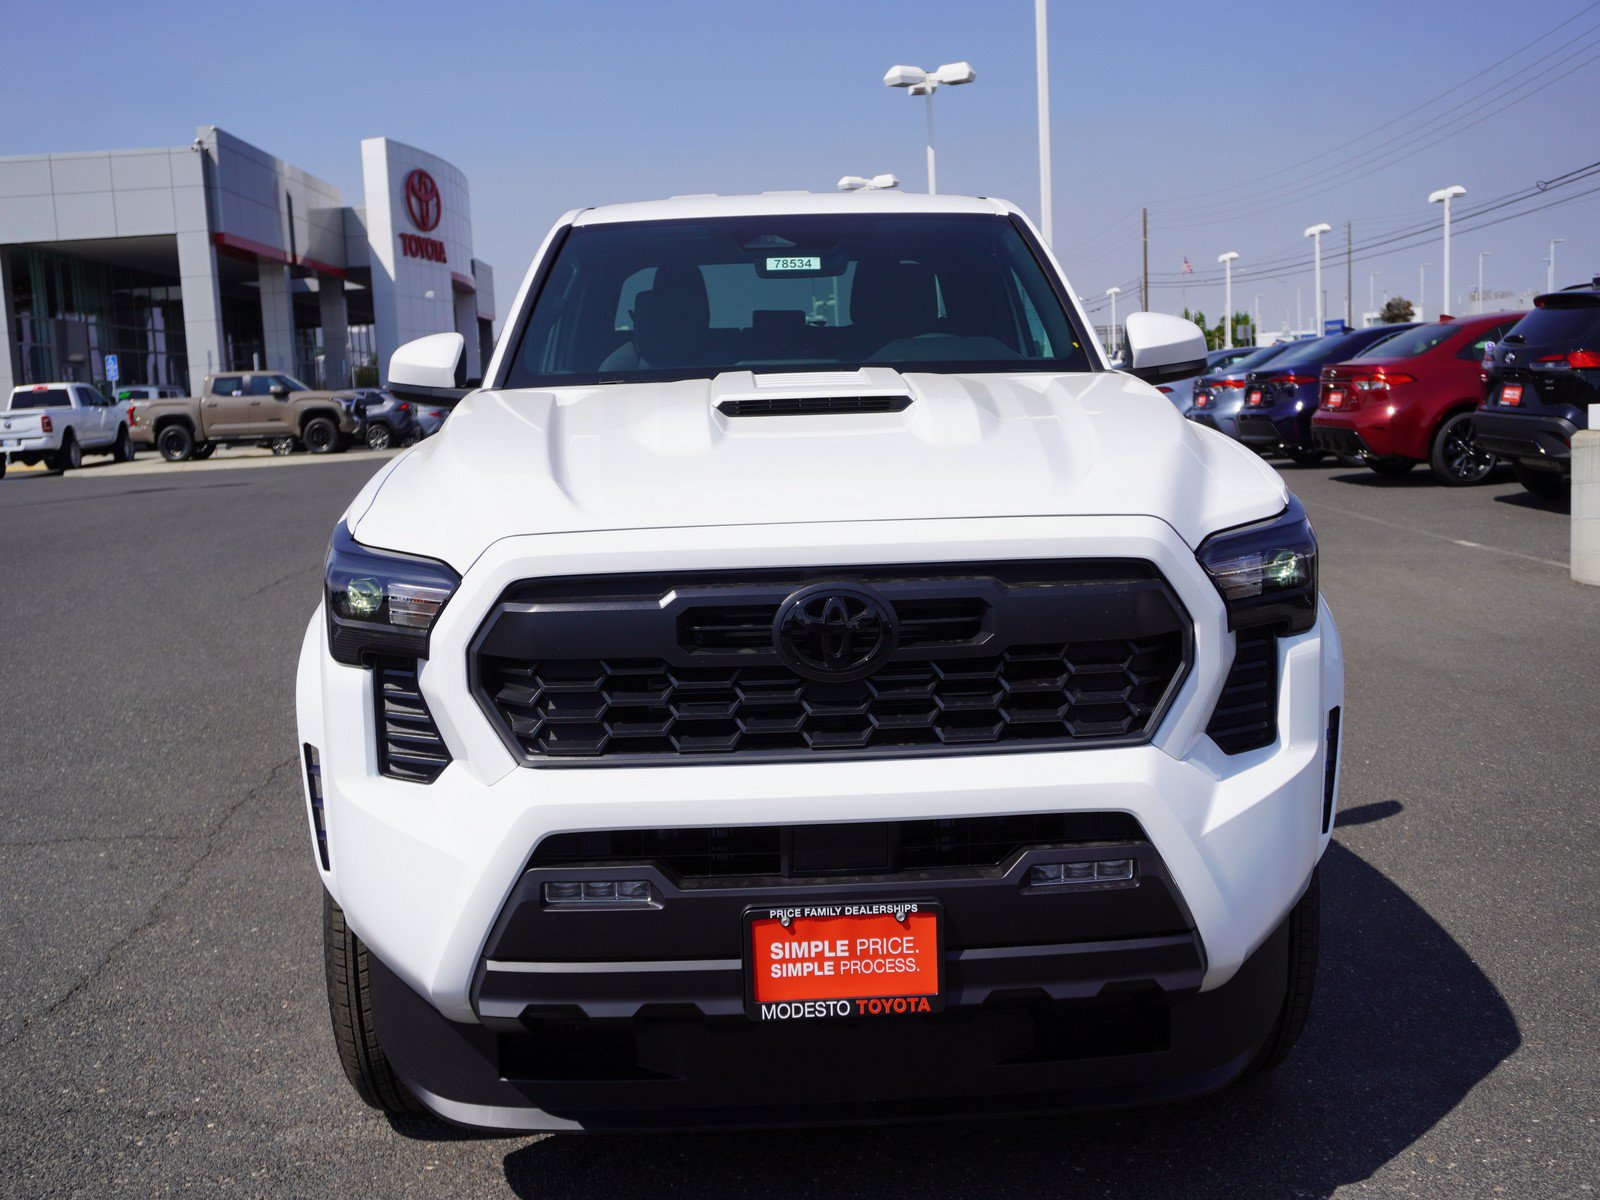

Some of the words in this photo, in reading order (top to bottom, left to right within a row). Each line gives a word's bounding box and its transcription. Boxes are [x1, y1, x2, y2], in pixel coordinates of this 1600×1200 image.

[399, 233, 448, 264] TOYOTA
[774, 259, 812, 268] 78534
[769, 908, 802, 919] PRICE
[804, 906, 842, 917] FAMILY
[845, 904, 918, 915] DEALERSHIPS
[770, 940, 849, 960] SIMPLE
[856, 937, 919, 956] PRICE.
[771, 961, 834, 978] SIMPLE
[840, 958, 920, 975] PROCESS.
[761, 1000, 851, 1020] MODESTO
[856, 997, 931, 1015] TOYOTA
